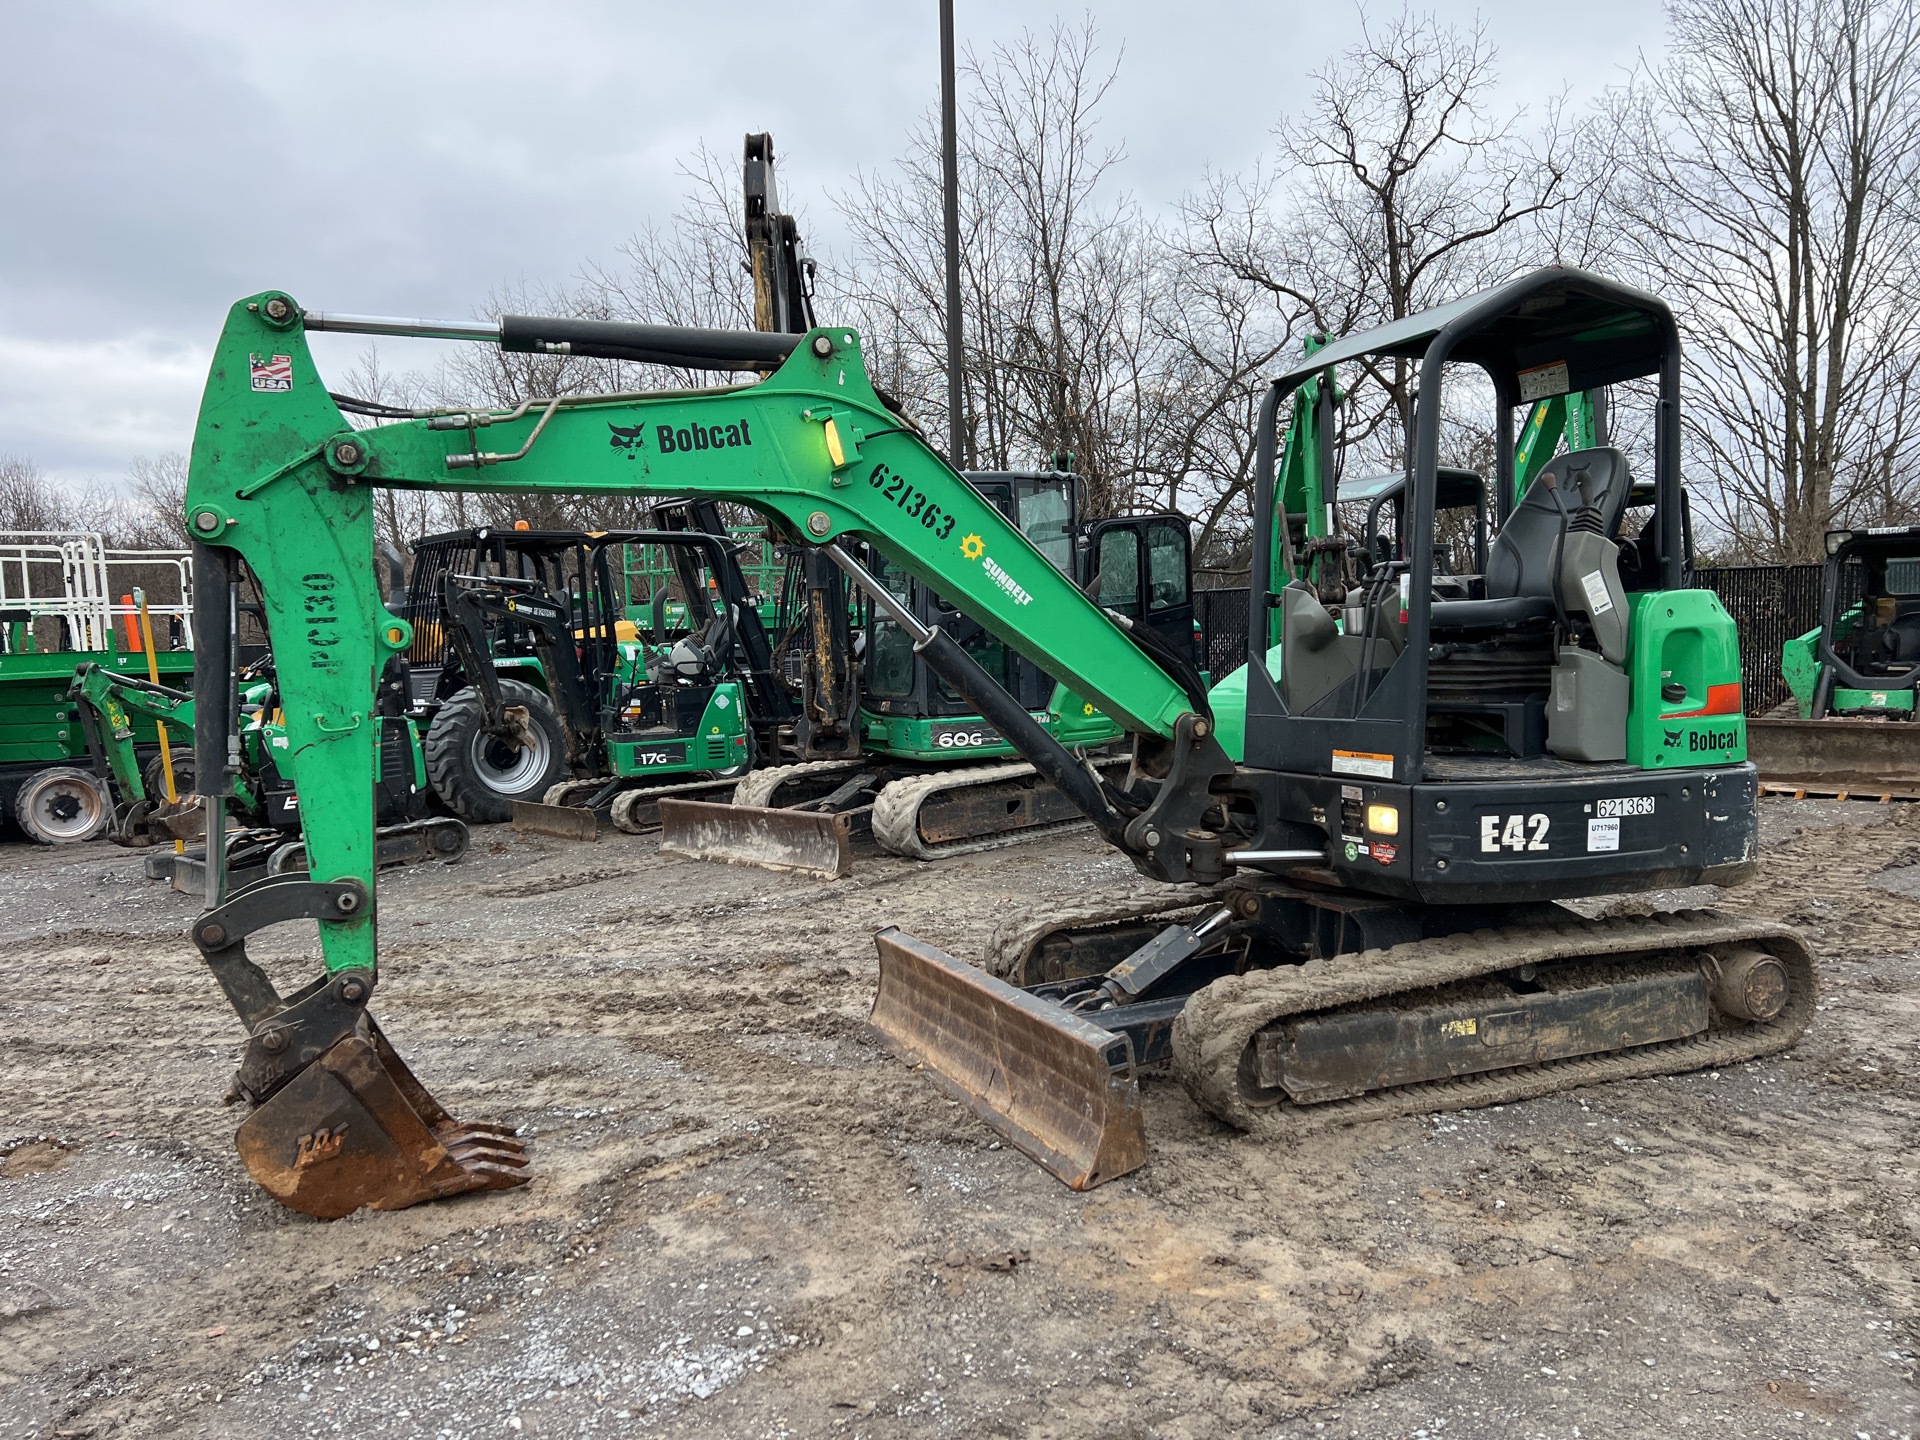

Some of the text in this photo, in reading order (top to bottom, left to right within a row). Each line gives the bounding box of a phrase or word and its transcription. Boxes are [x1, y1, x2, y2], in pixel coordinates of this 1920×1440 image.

[253, 379, 290, 389] USA
[656, 419, 752, 454] Bobcat
[869, 463, 956, 540] 621363
[981, 556, 1034, 606] SUNBELT
[938, 732, 982, 747] 60G
[1689, 728, 1738, 752] Bobcat
[640, 752, 667, 765] 17G
[1599, 797, 1654, 817] 621363
[1481, 813, 1550, 852] E42
